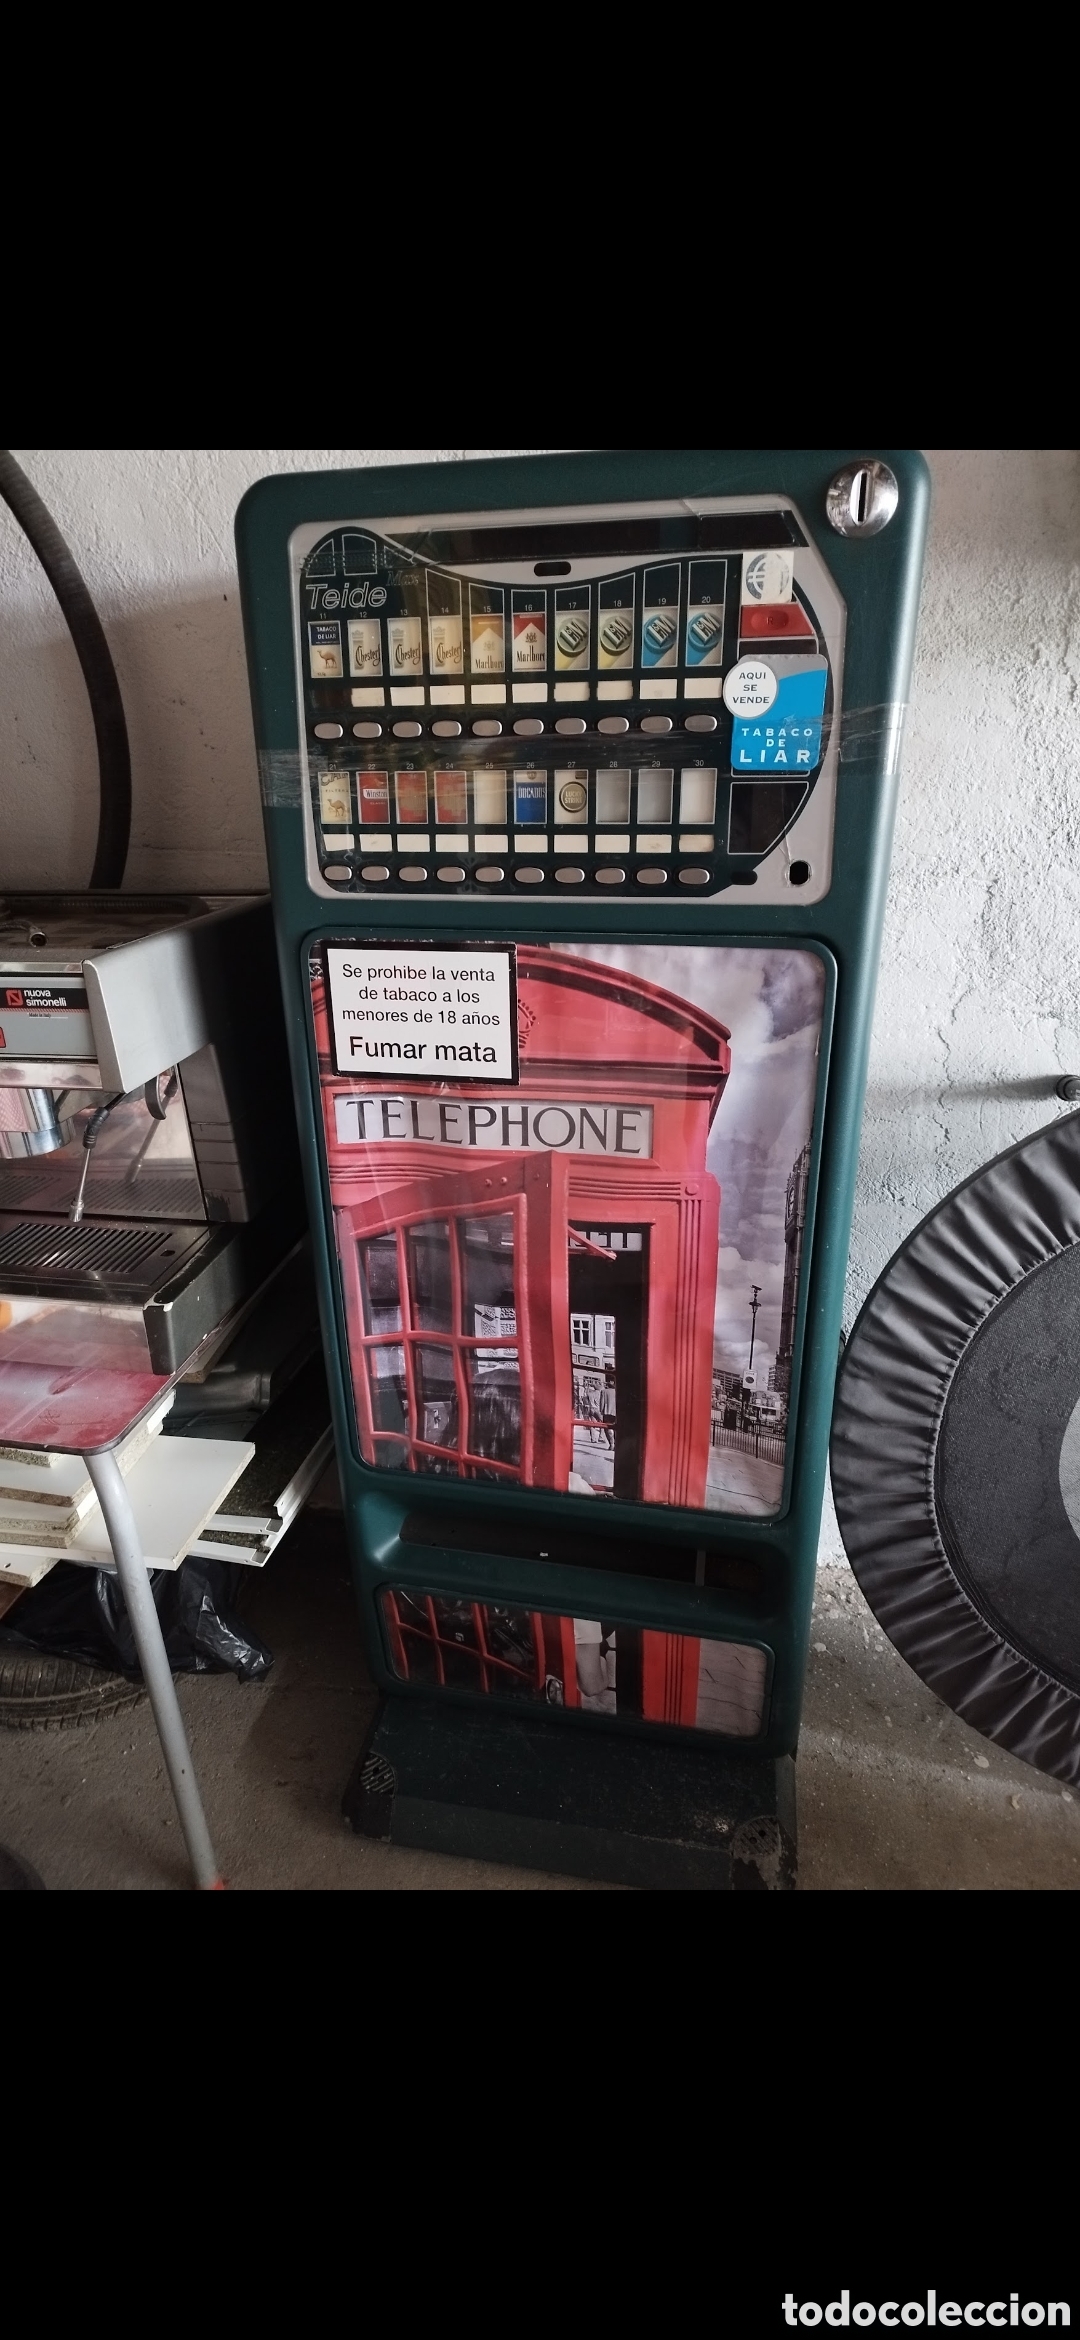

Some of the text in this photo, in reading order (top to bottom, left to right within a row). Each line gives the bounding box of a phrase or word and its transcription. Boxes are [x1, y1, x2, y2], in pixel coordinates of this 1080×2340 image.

[306, 582, 388, 610] Teide
[739, 672, 766, 680] AQUI
[743, 684, 758, 692] SE
[732, 696, 770, 704] VENDE
[742, 727, 813, 736] TABACO
[766, 738, 786, 747] DE
[740, 749, 811, 764] LIAR
[366, 790, 388, 798] Winston
[342, 964, 496, 982] Se prohibe la venta
[359, 987, 480, 1003] de tabaco a los
[26, 997, 67, 1006] simonelli
[342, 1009, 500, 1026] menores de 18 años
[350, 1036, 497, 1063] Fumar mata
[346, 1099, 641, 1154] TELEPHONE
